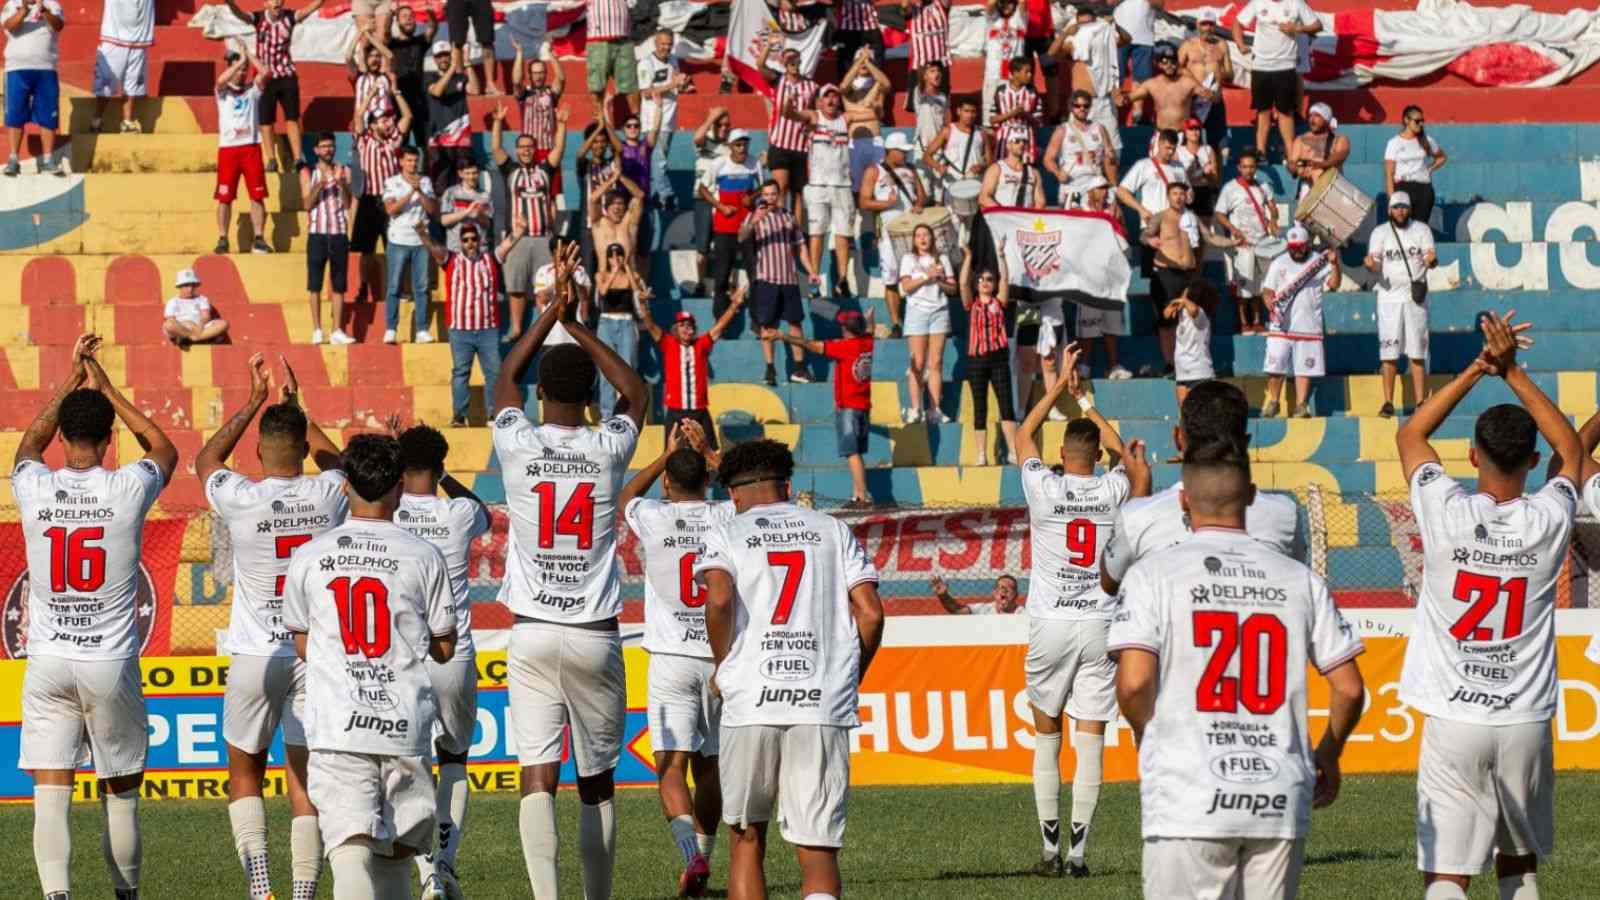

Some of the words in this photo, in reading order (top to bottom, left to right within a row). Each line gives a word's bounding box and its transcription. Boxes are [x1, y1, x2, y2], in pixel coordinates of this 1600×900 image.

[544, 463, 600, 474] DELPHOS
[55, 508, 114, 520] DELPHOS
[274, 514, 330, 529] DELPHOS
[531, 481, 595, 549] 14
[409, 527, 450, 537] ELPHOS
[763, 531, 821, 543] DELPHOS
[1066, 518, 1097, 568] 9
[43, 526, 107, 593] 16
[338, 555, 399, 571] DELPHOS
[1472, 549, 1537, 566] DELPHOS
[549, 572, 579, 582] FUEL
[767, 550, 805, 625] 7
[1212, 584, 1287, 602] DELPHOS
[533, 590, 585, 611] junpe
[1054, 597, 1098, 609] junpe
[1449, 569, 1528, 641] 21
[326, 576, 391, 659] 10
[268, 630, 296, 643] jun
[761, 640, 783, 650] TEM
[776, 660, 810, 671] FUEL
[1192, 610, 1288, 715] 20
[1473, 664, 1508, 679] FUEL
[756, 686, 821, 706] junpe
[344, 710, 408, 735] junpe
[1206, 732, 1236, 745] TEM
[1230, 757, 1272, 771] FUEL
[1206, 788, 1287, 815] junpe
